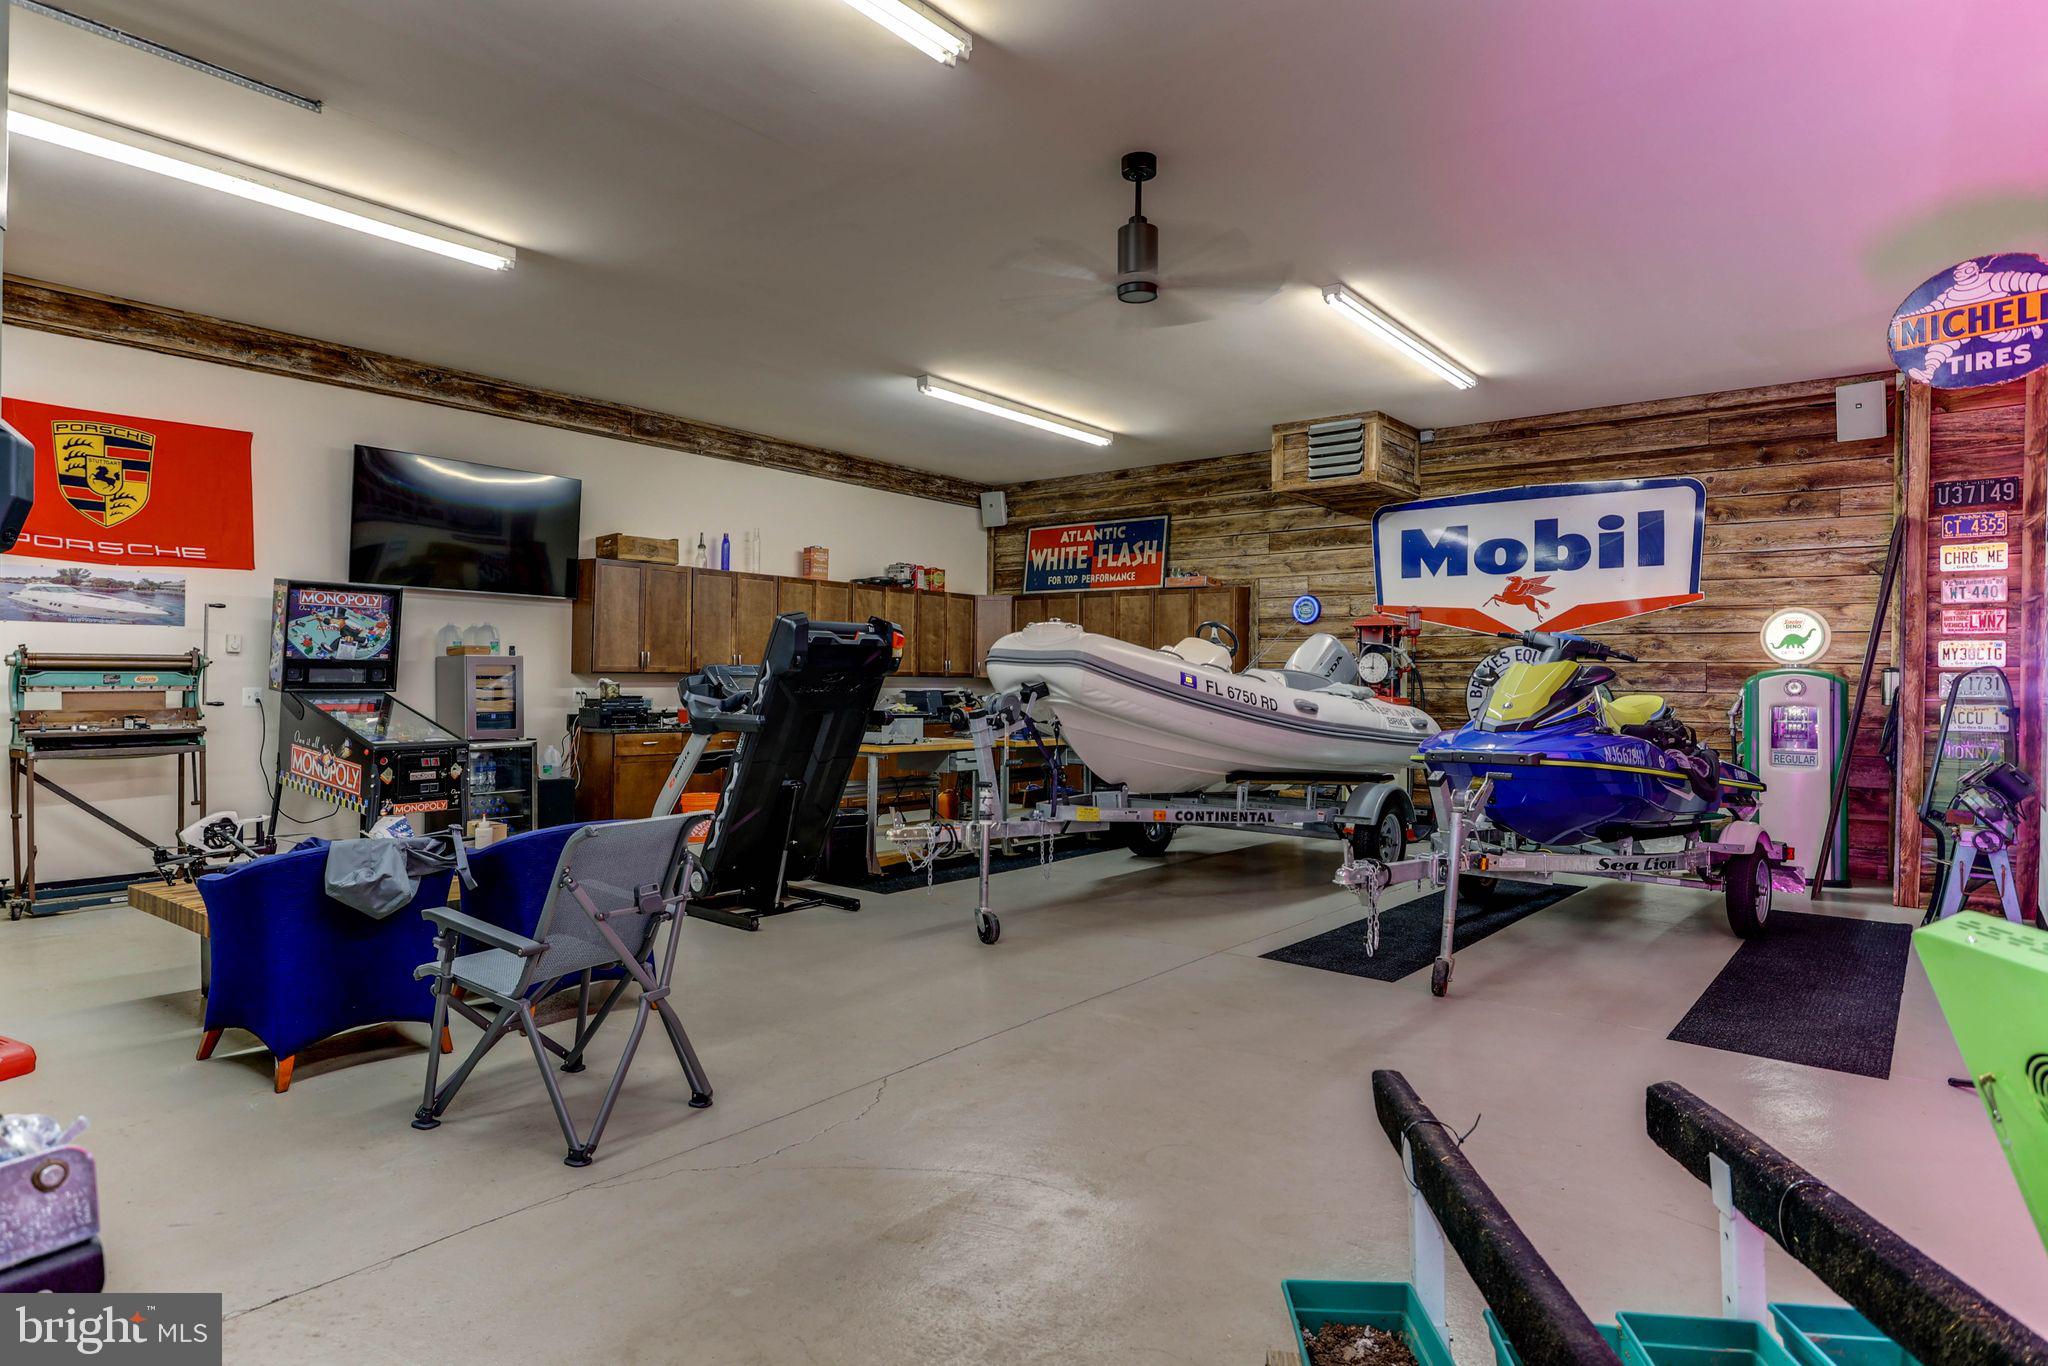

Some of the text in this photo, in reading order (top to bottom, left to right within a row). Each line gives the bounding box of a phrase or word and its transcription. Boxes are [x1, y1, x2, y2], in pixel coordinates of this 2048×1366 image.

[1945, 343, 2032, 375] TIRES
[55, 423, 152, 443] PORSCHE
[88, 458, 122, 466] STUTTGART
[1944, 520, 1962, 534] CT
[1971, 517, 2005, 532] 4355
[1060, 525, 1127, 543] ATLANTIC
[1401, 509, 1665, 579] Mobil
[1031, 540, 1158, 571] WHITE FLASH
[1944, 549, 2004, 564] CHRG ME
[1047, 571, 1136, 585] FOR TOP PERFORMANCE
[301, 591, 380, 606] MONOPOLY
[1969, 614, 2005, 628] LWN7
[1470, 650, 1511, 698] BRKES
[1206, 680, 1223, 696] FL
[1227, 686, 1257, 706] 6750
[1261, 696, 1278, 711] RD
[1387, 716, 1408, 726] BRIG
[1773, 753, 1816, 765] REGULAR
[292, 748, 360, 790] MONOPOLY
[395, 800, 447, 814] MONOPOLY
[1175, 810, 1275, 823] CONTINENTAL
[1596, 857, 1677, 871] Sea Lion
